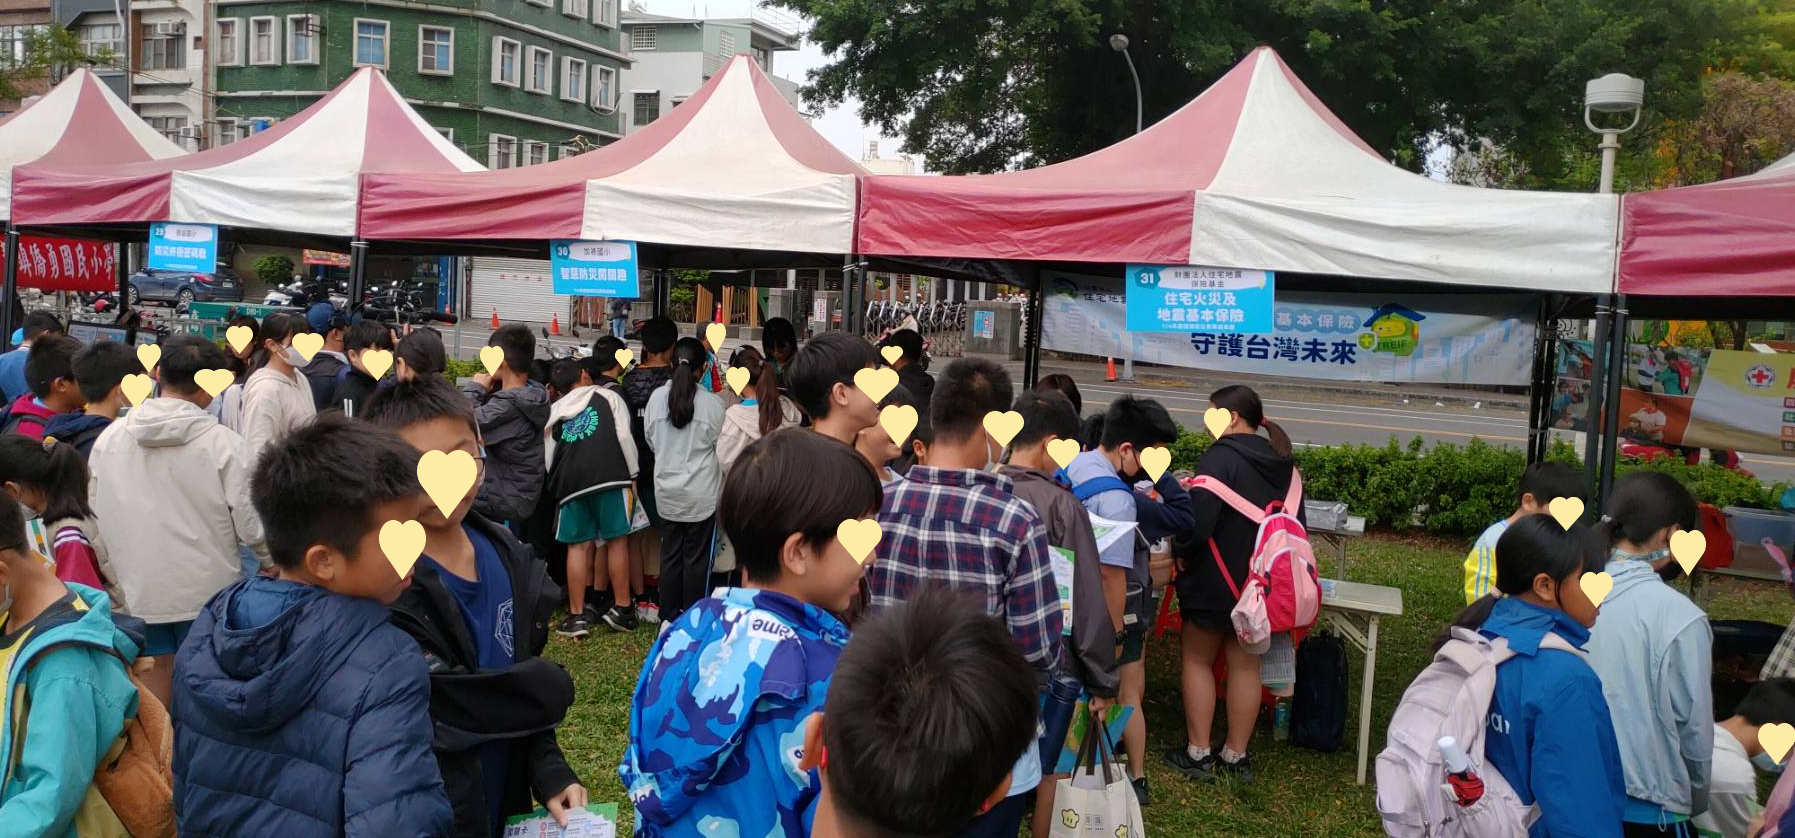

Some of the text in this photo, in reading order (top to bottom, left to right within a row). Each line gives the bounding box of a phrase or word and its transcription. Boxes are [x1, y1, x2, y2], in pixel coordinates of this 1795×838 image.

[557, 247, 568, 256] 30
[0, 242, 114, 280] 鎮僑勇國民小學
[1140, 273, 1154, 284] 31
[1174, 270, 1242, 279] 財團法人住宅地震
[1164, 292, 1237, 306] 住宅火災及
[1157, 308, 1245, 322] 地震基本保險
[1276, 312, 1356, 329] 基本保險
[1191, 332, 1357, 365] 守護台灣未來
